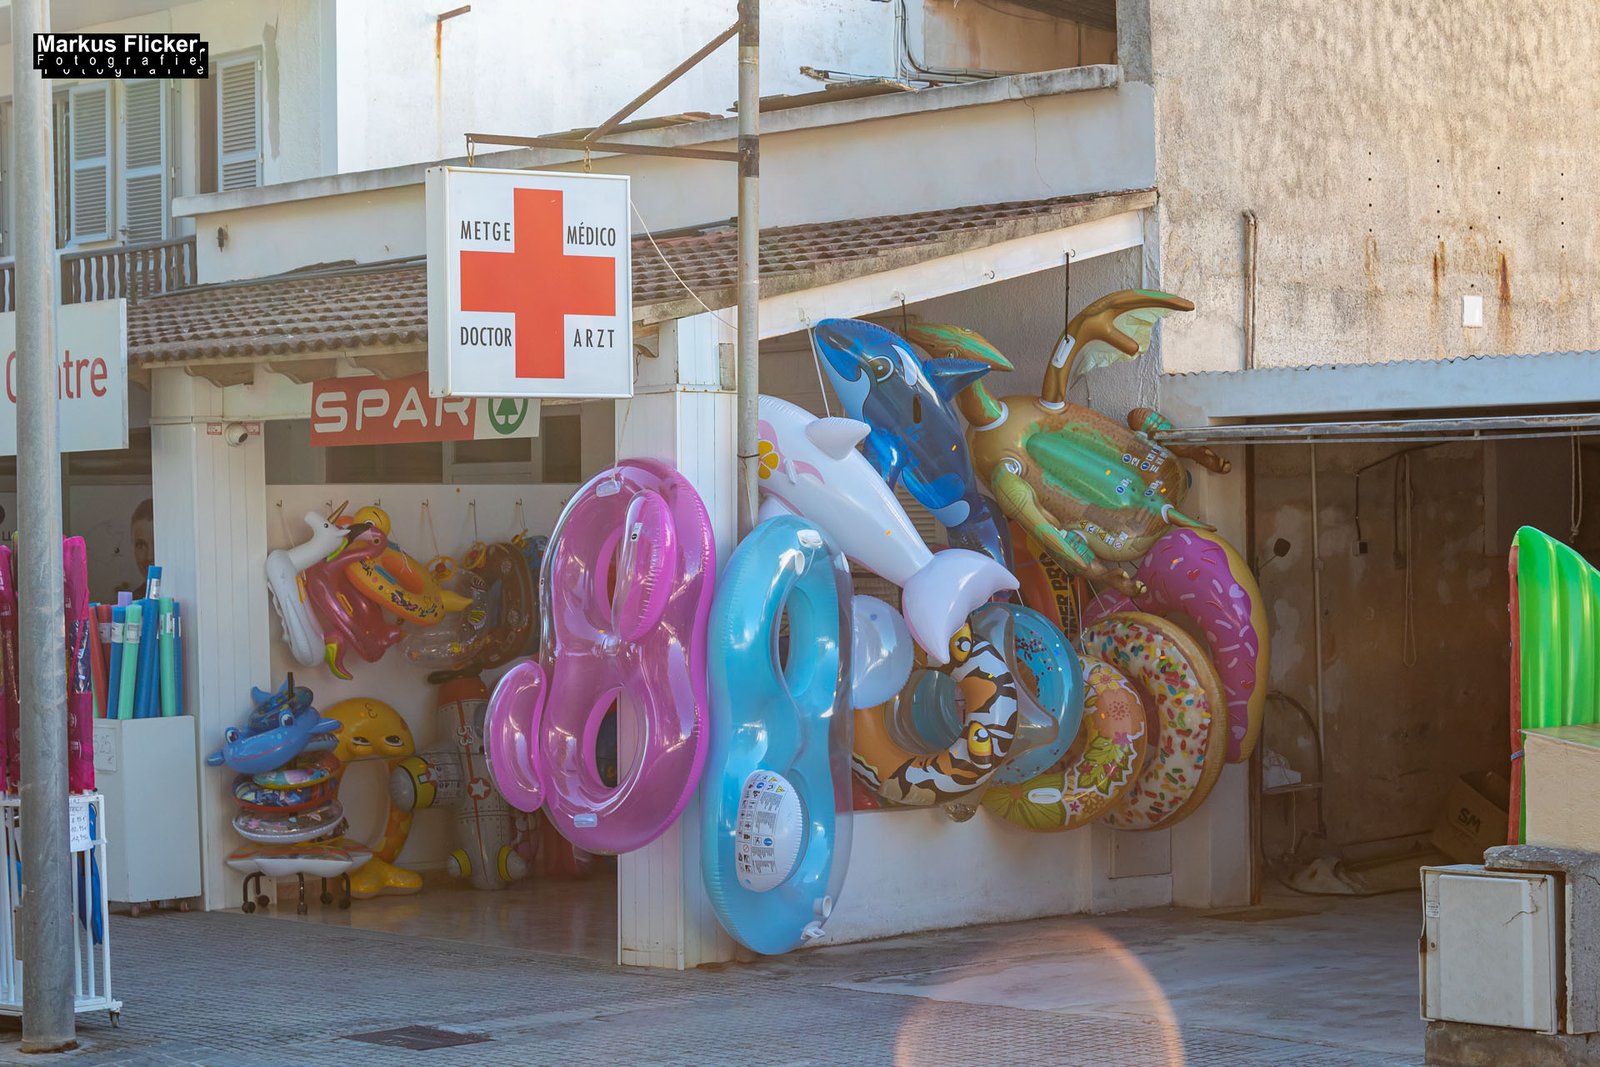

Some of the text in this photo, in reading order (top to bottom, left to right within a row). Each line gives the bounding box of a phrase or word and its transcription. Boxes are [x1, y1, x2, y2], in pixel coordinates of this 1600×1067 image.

[460, 220, 511, 242] METGE
[567, 222, 616, 247] MÉDICO
[460, 326, 512, 347] DOCTOR
[573, 329, 615, 348] ARZT
[6, 350, 107, 404] Ctre
[313, 386, 471, 433] SPAR
[1458, 807, 1481, 834] SM
